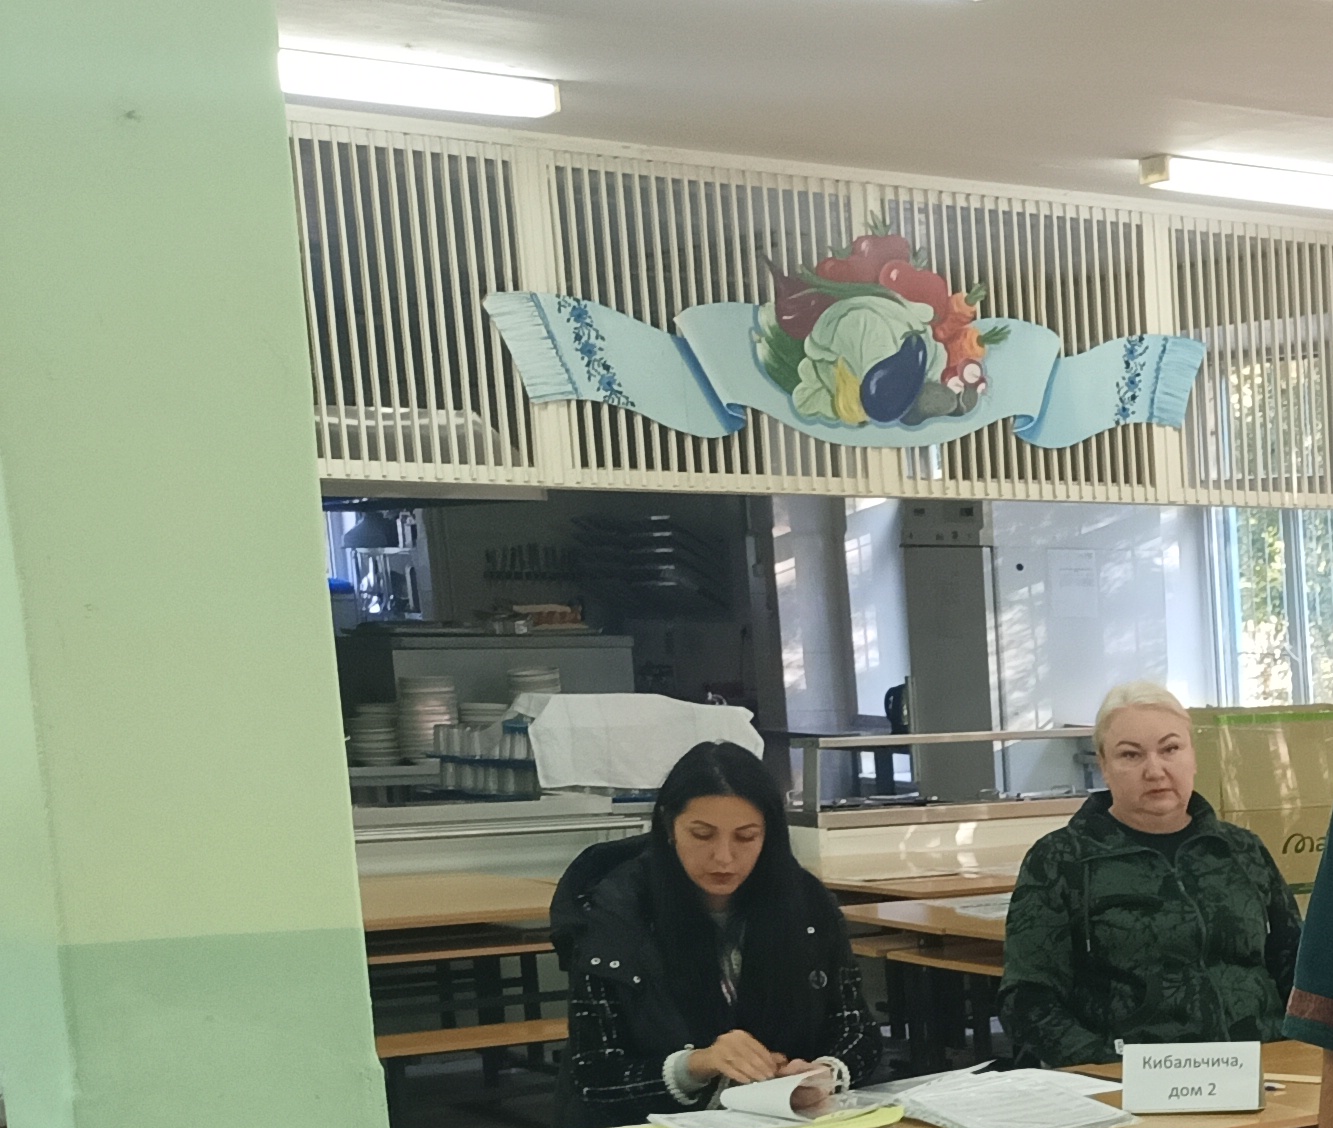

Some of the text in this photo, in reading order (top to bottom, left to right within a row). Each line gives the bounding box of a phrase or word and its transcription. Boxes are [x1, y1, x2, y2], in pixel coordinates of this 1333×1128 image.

[1142, 1055, 1244, 1070] Кибальчича,
[1168, 1082, 1217, 1100] дом 2
